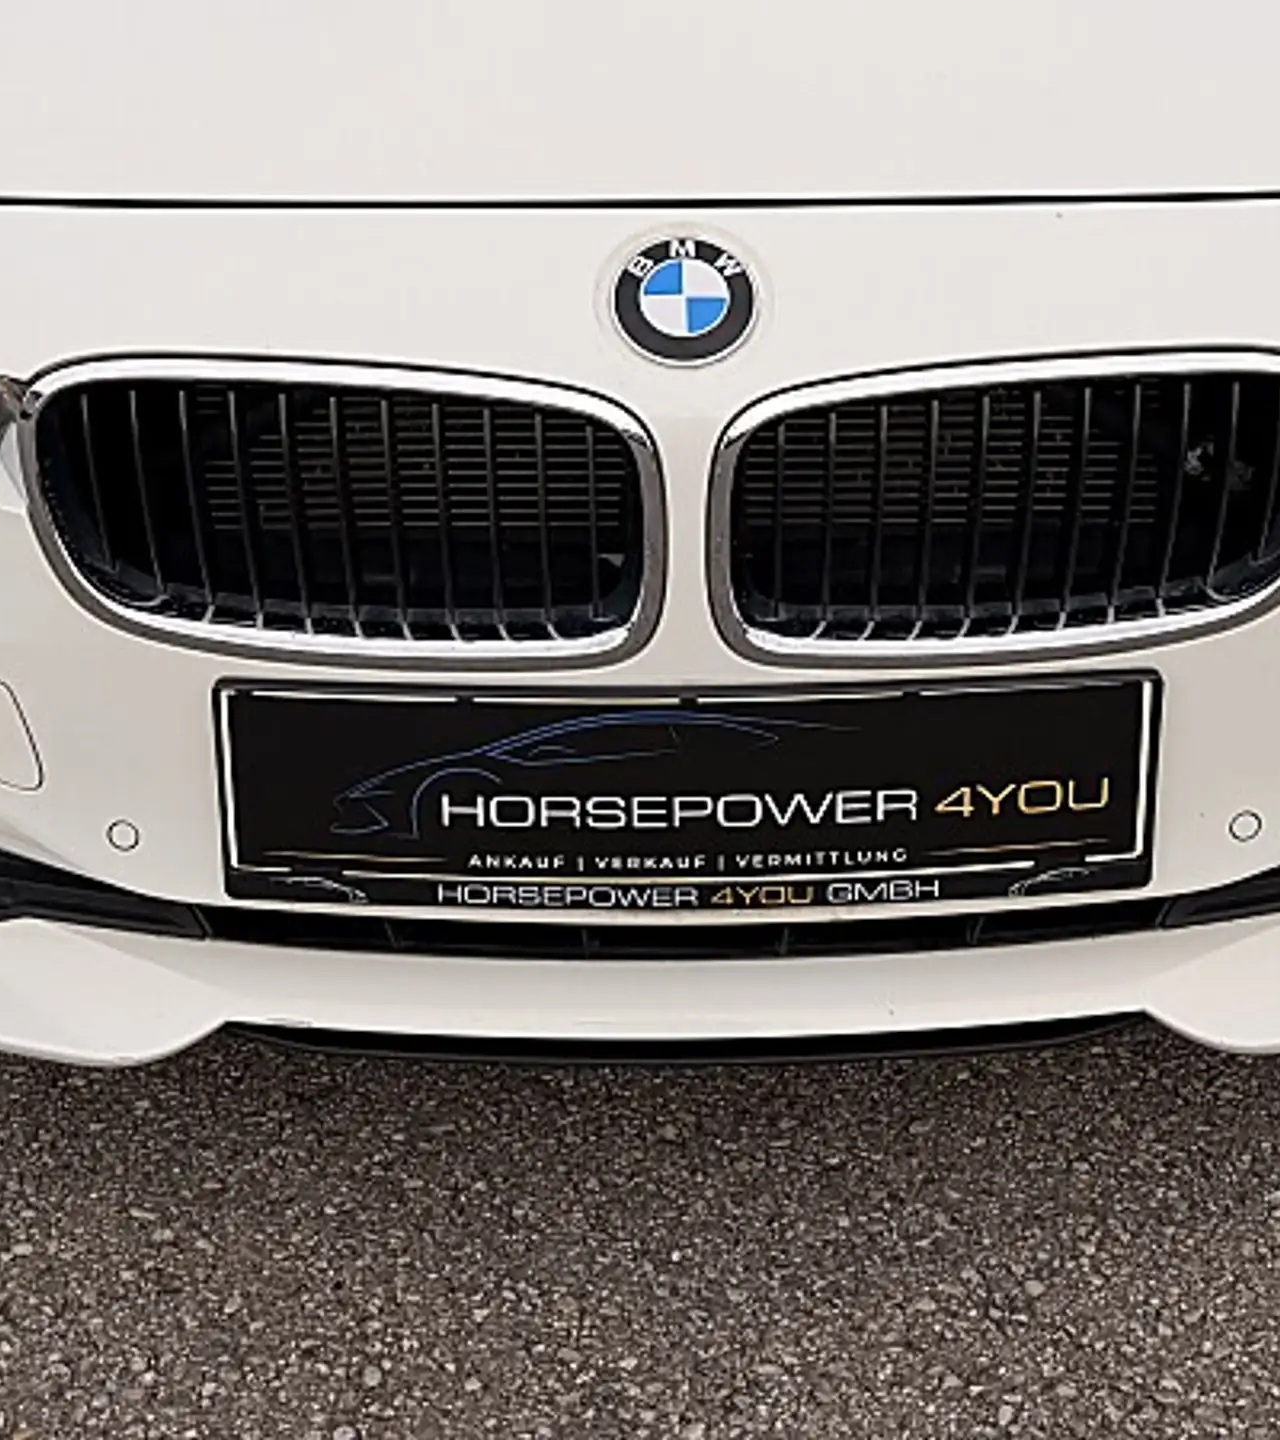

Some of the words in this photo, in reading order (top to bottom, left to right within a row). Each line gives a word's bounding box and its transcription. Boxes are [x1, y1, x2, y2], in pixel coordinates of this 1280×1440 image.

[627, 239, 743, 277] BMW
[440, 789, 918, 829] HORSEPOWER
[934, 777, 1109, 817] 4YOU
[468, 854, 565, 869] ANKAUF
[595, 855, 706, 870] VERKAUF
[735, 847, 908, 869] VERMITTLUNG
[437, 883, 700, 907] HORSEPOWER
[710, 885, 815, 904] 4YOU
[826, 879, 940, 903] GMBH
